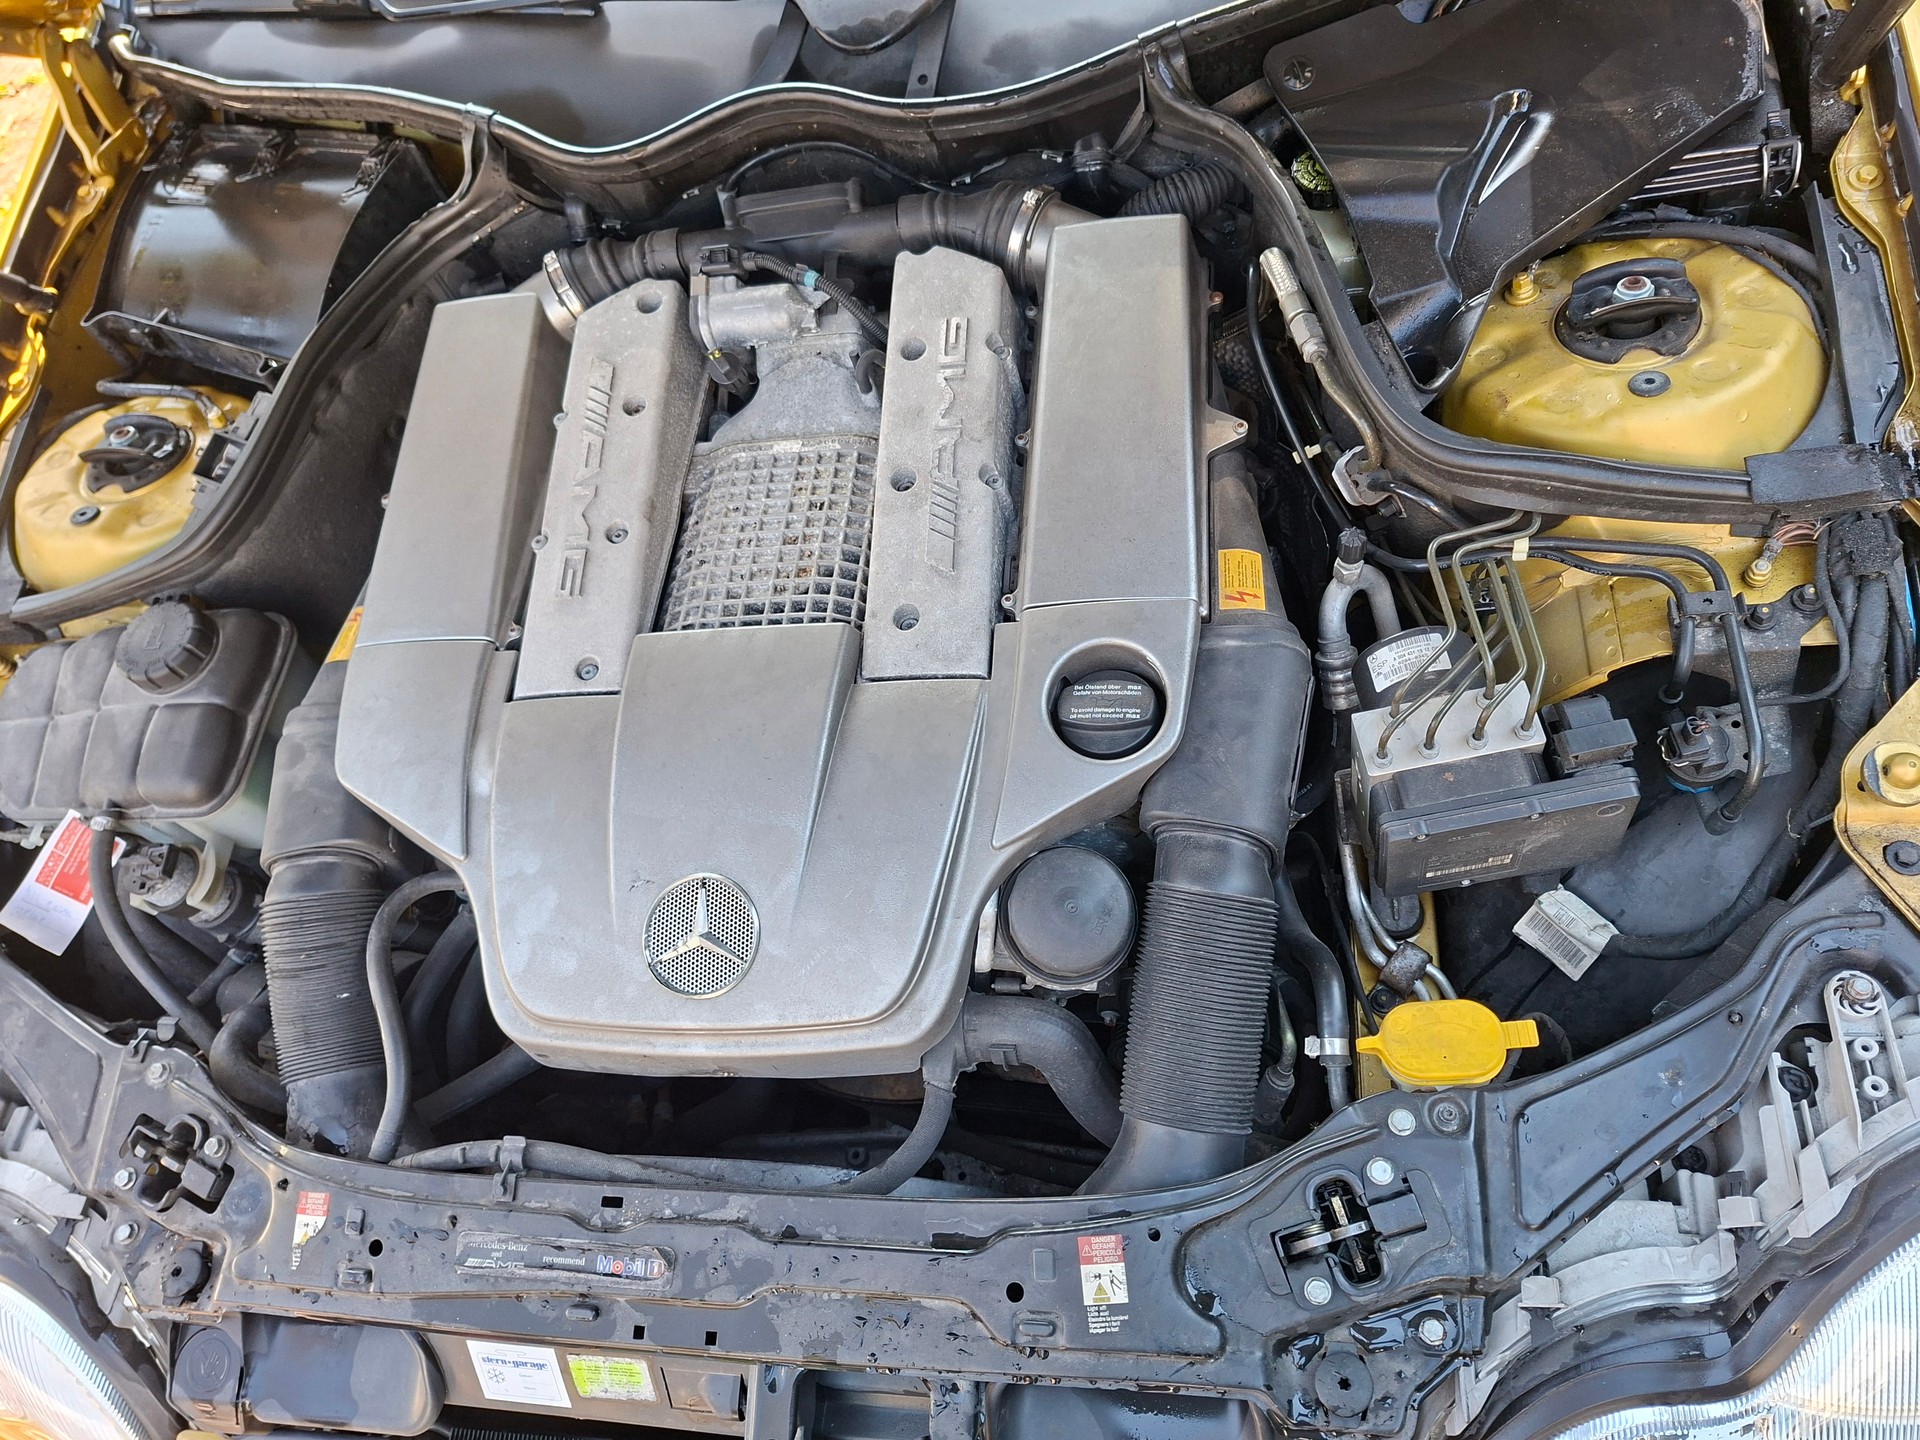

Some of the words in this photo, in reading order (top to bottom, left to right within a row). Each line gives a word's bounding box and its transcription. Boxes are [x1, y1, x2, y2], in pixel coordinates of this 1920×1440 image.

[1372, 659, 1388, 674] ESP
[467, 1240, 529, 1252] Mercedes-Benz
[542, 1256, 586, 1266] recommend
[597, 1254, 645, 1277] Mobil
